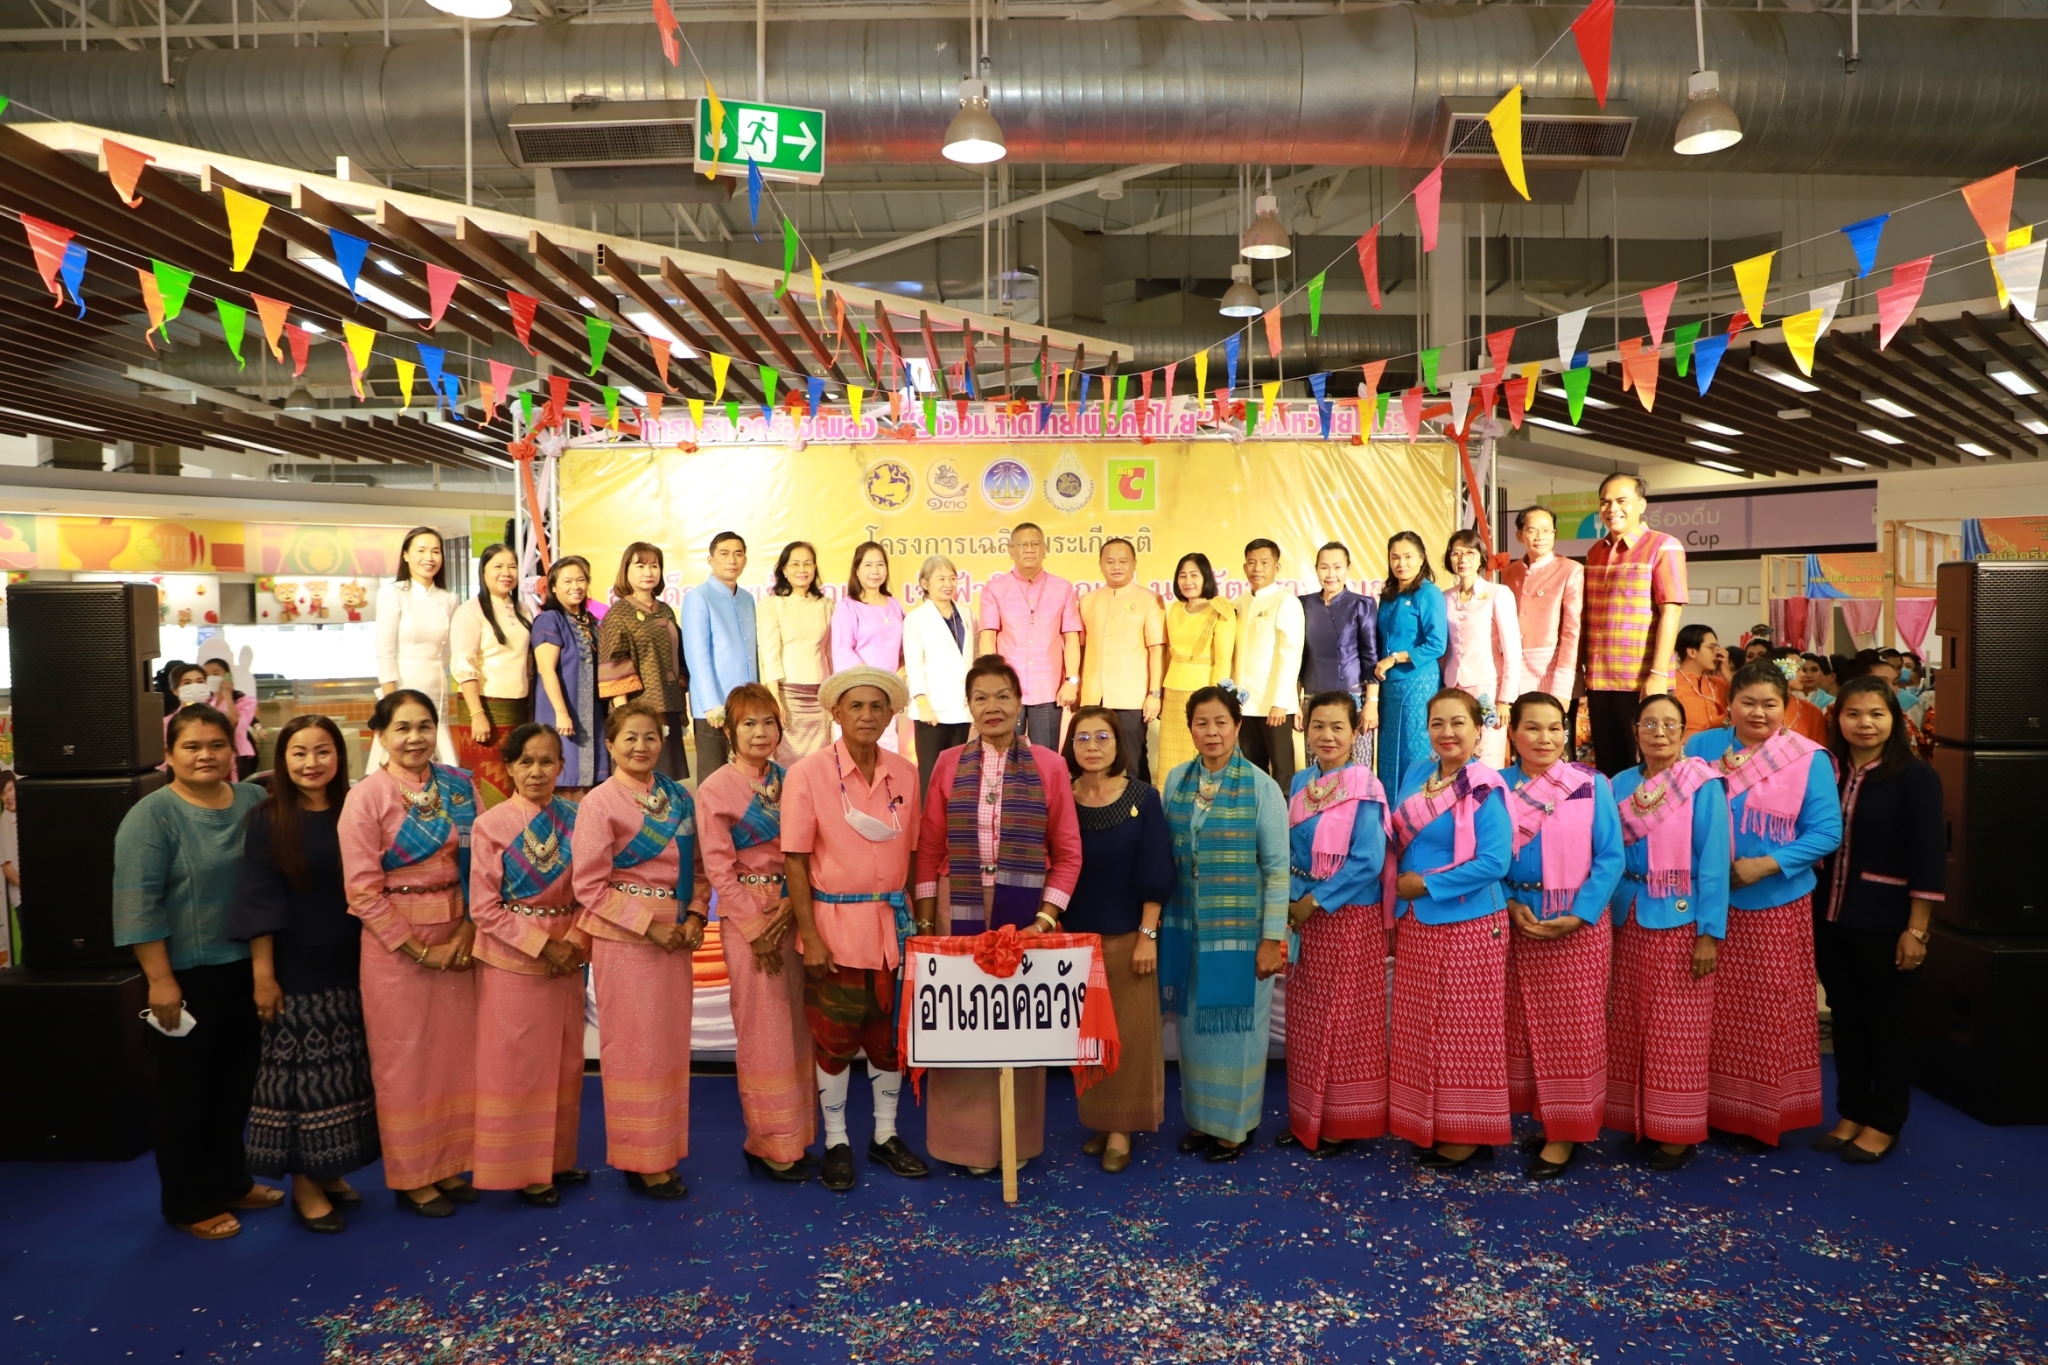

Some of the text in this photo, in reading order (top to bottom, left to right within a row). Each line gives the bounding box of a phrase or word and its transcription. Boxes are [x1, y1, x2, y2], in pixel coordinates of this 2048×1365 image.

[1117, 467, 1134, 478] Big
[927, 498, 967, 510] ๑๓๐
[866, 525, 1151, 555] โครงการเฉลิระเกีติ
[1686, 530, 1720, 549] Cup
